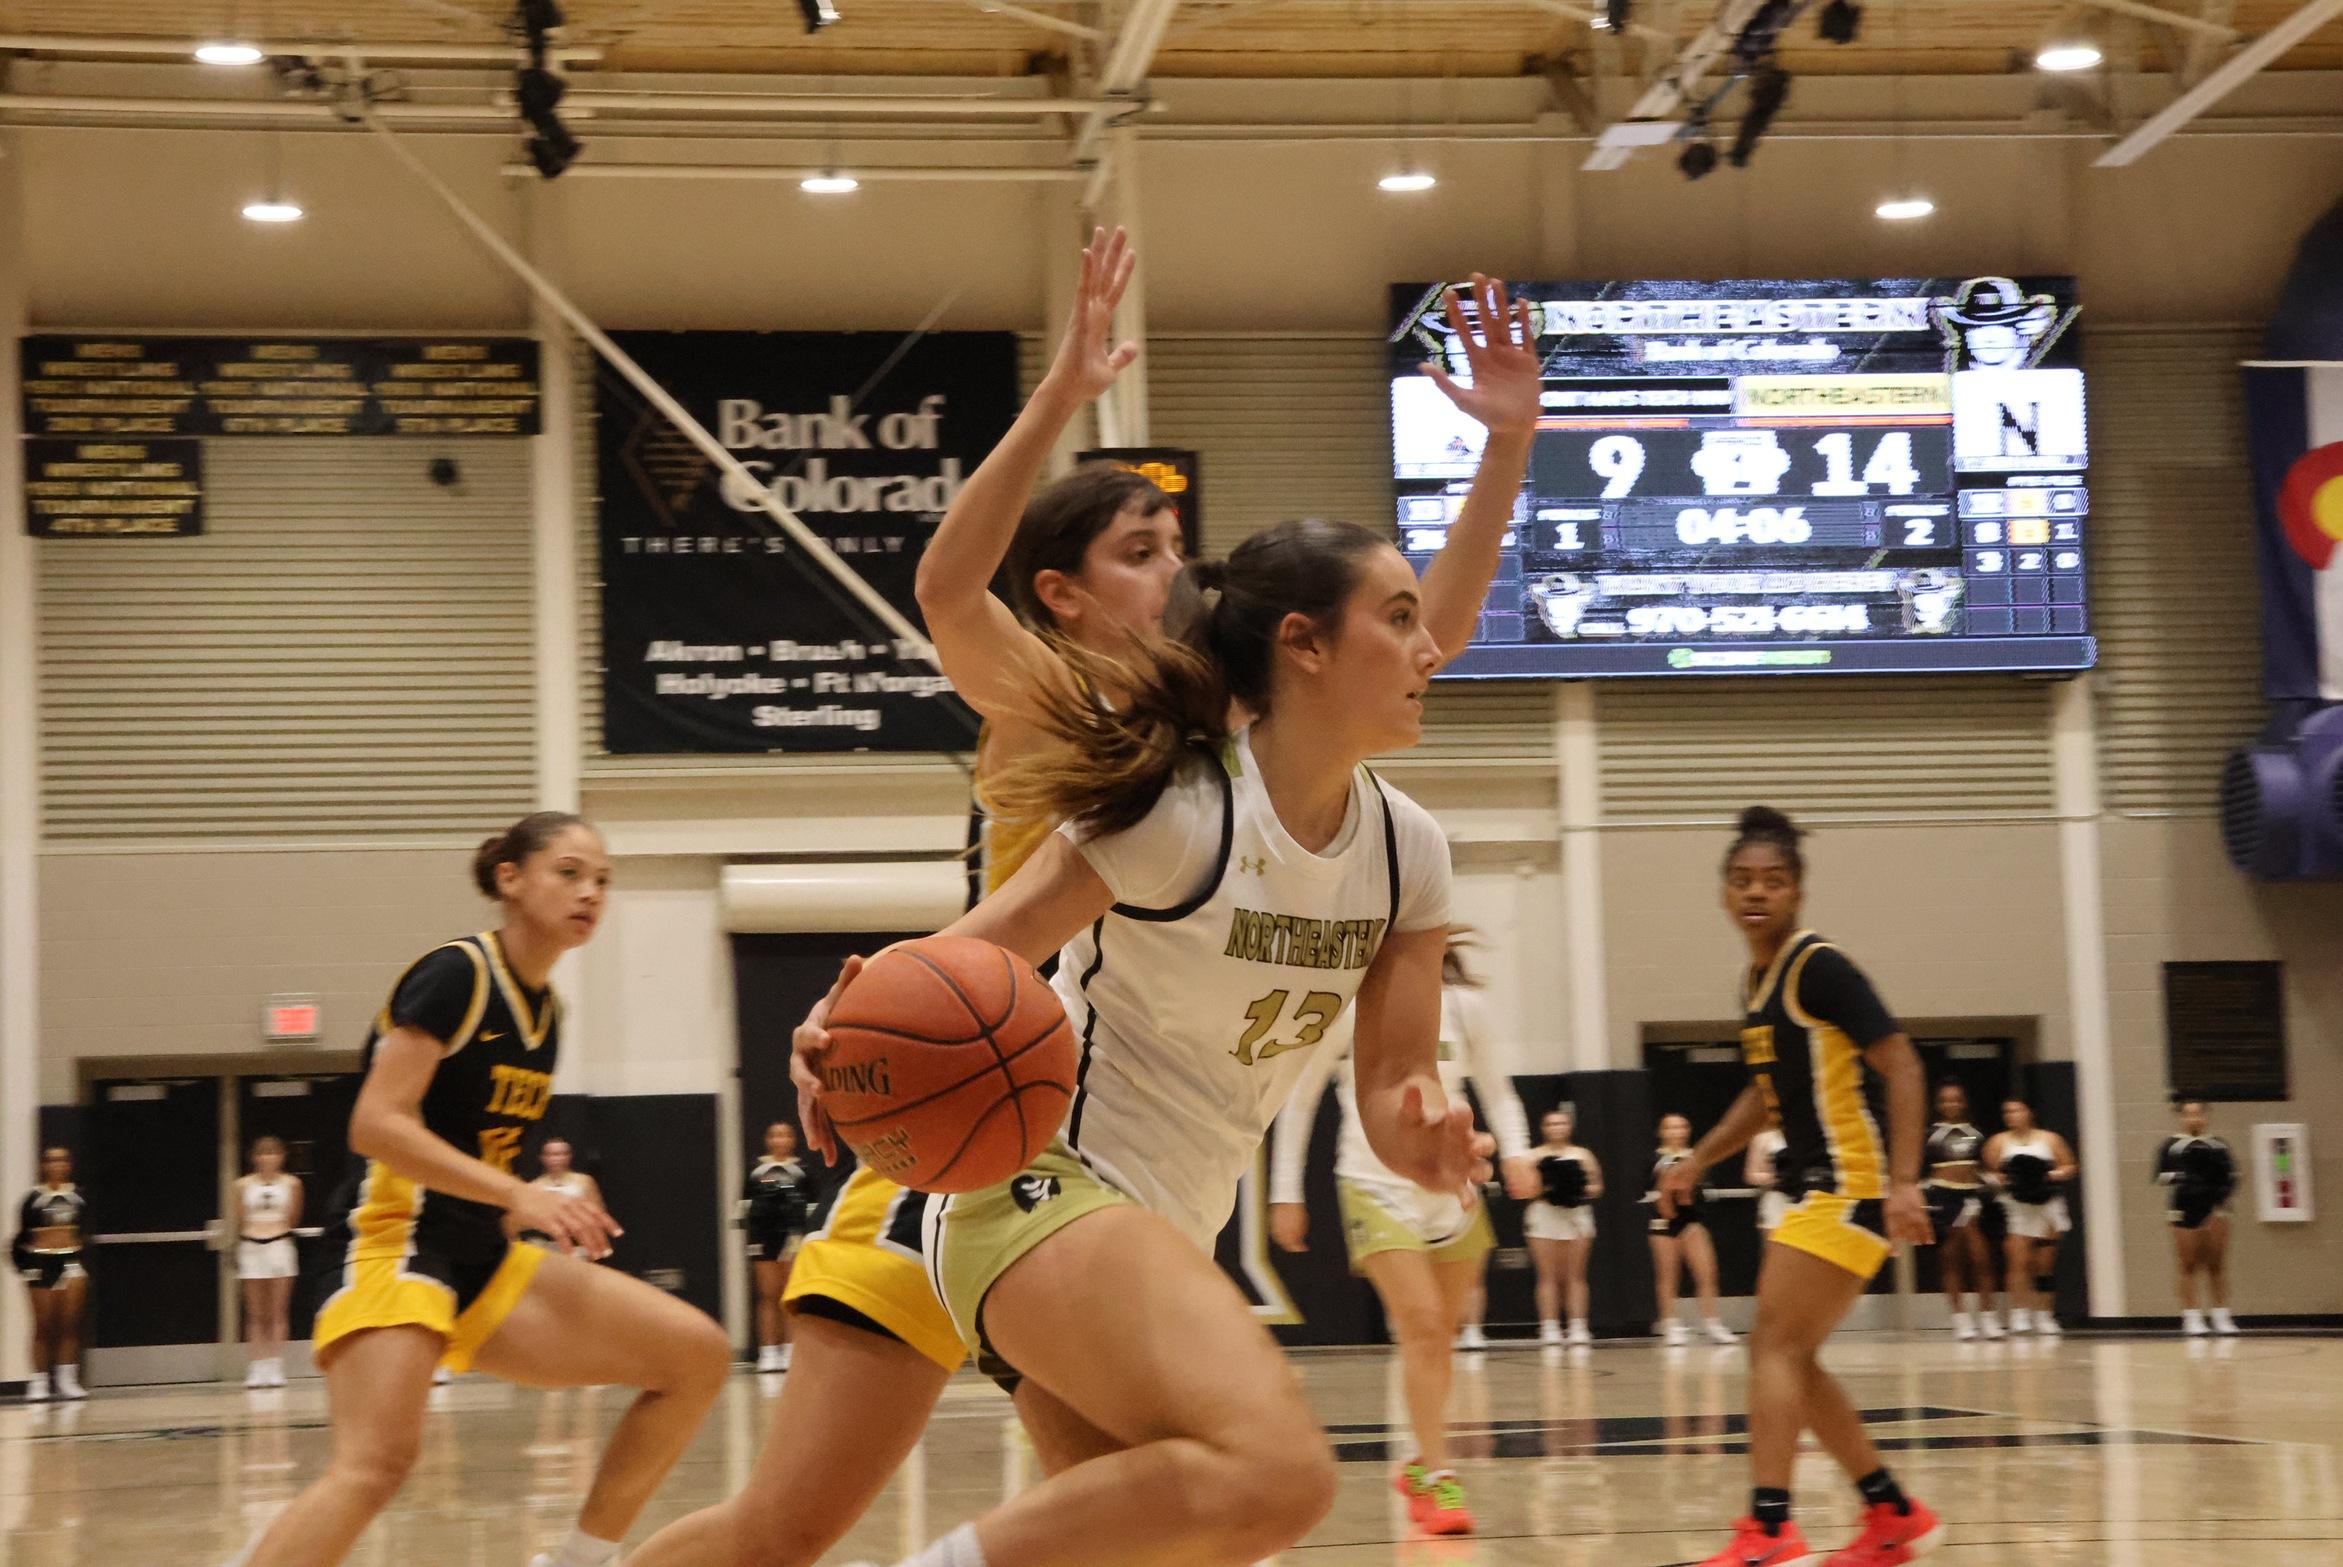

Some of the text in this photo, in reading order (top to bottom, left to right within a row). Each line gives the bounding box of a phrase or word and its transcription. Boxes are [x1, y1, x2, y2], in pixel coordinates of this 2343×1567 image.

[717, 395, 946, 449] Bank of
[719, 458, 966, 512] Colorad
[1589, 435, 1646, 499] 9
[1811, 432, 1921, 495] 14
[1554, 521, 1586, 550] 1
[1903, 518, 1935, 546] 2
[853, 672, 956, 697] Morga
[1228, 989, 1342, 1066] 13
